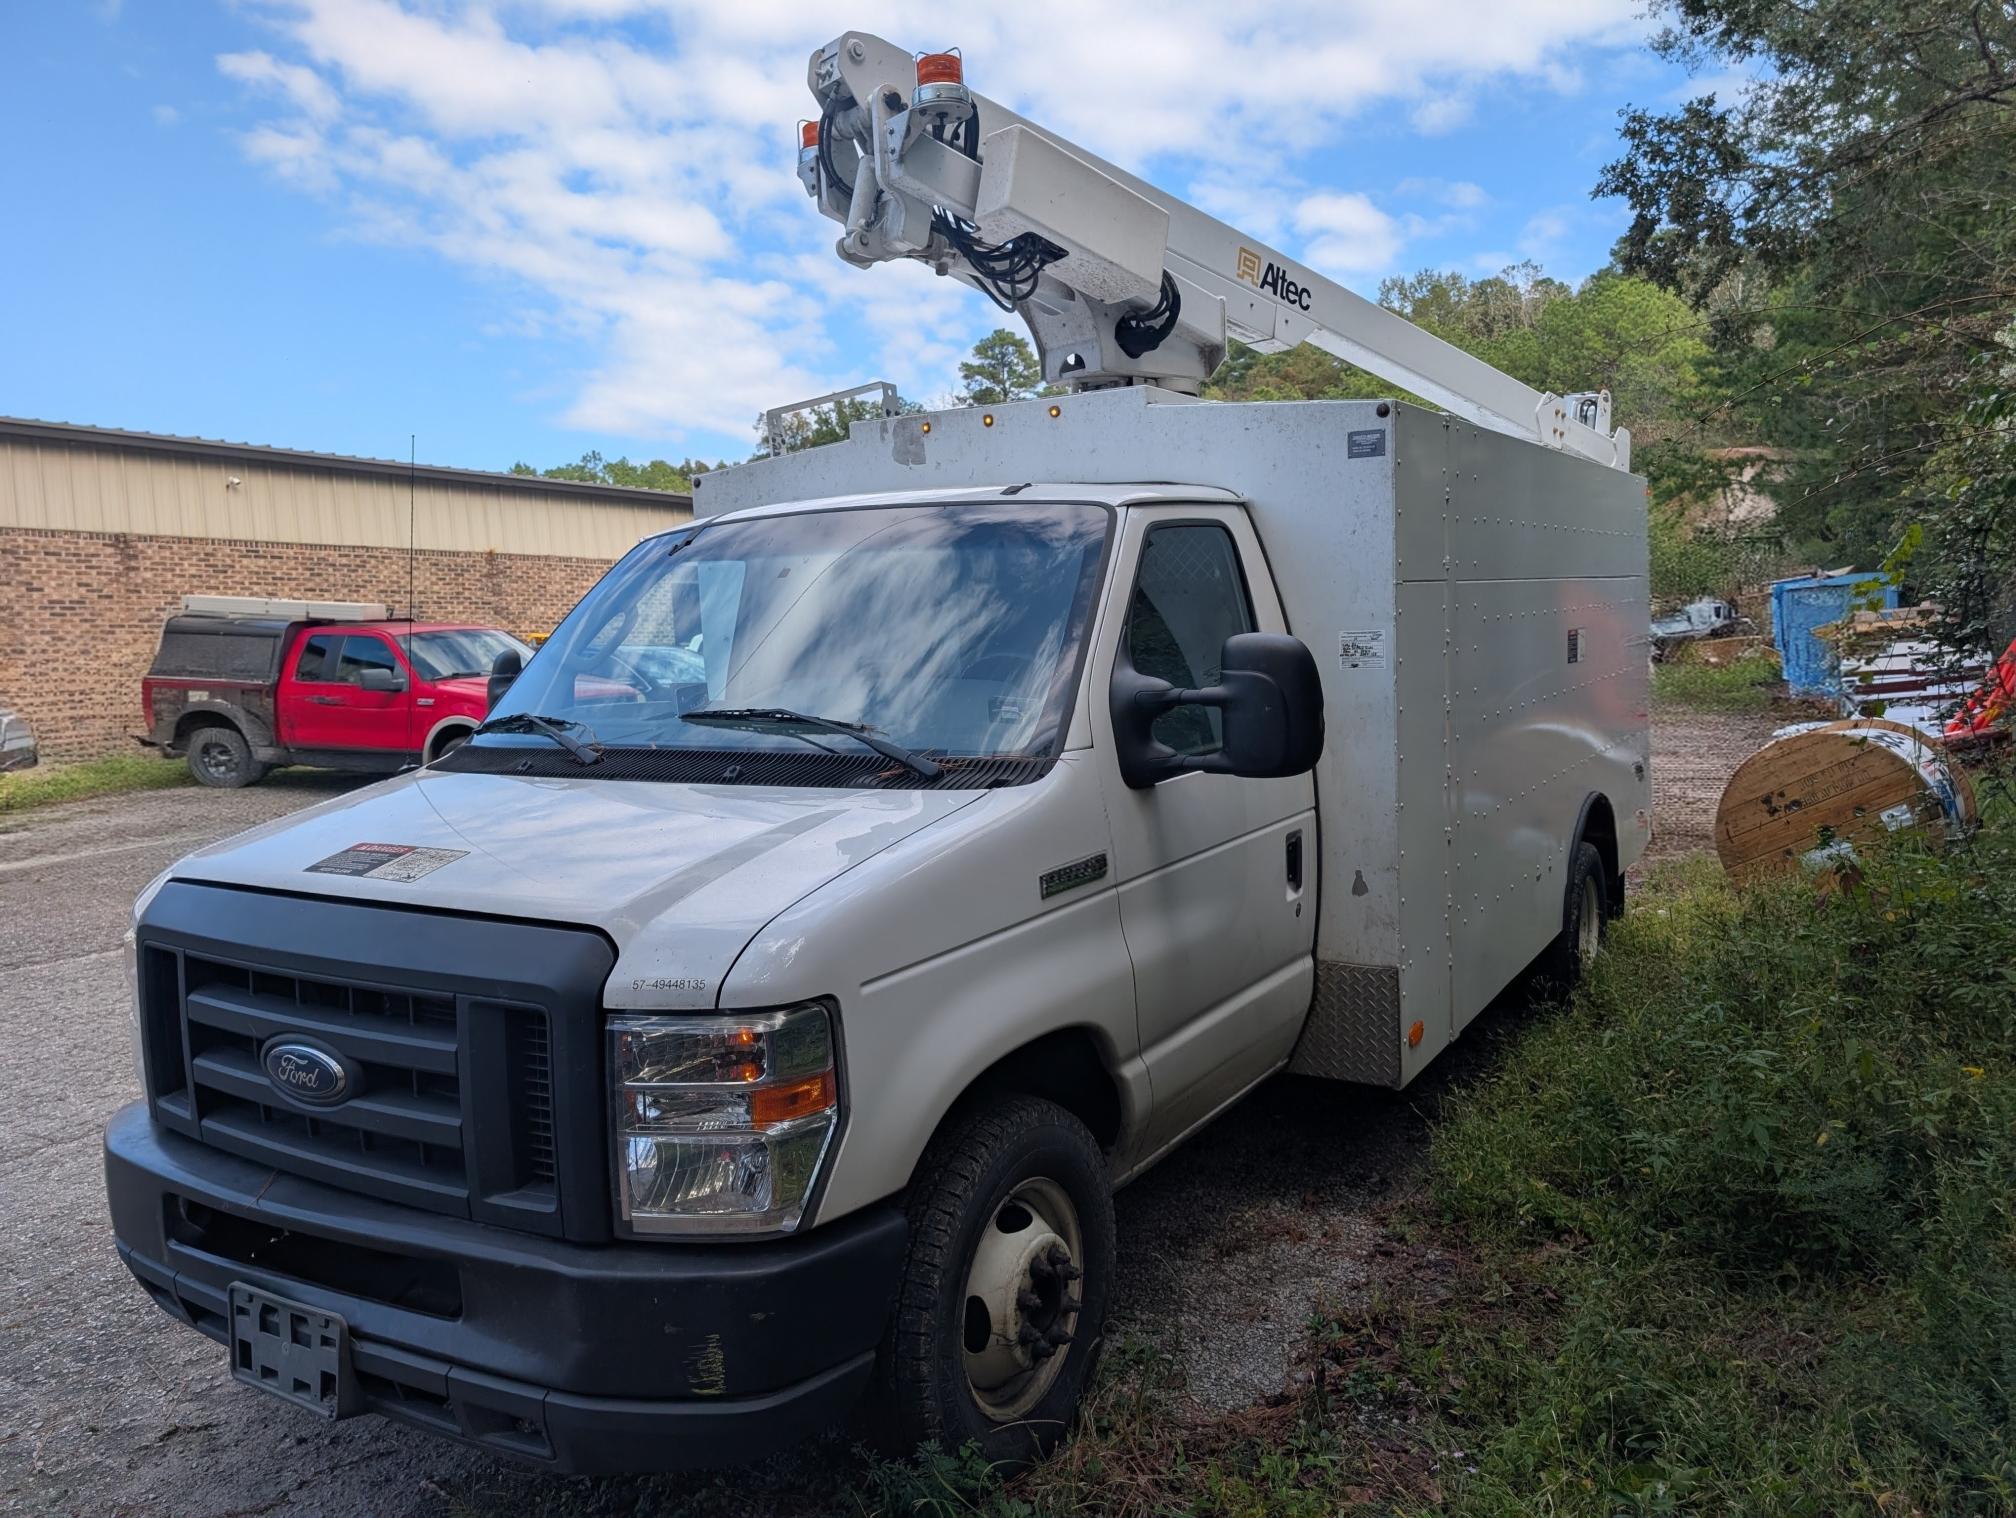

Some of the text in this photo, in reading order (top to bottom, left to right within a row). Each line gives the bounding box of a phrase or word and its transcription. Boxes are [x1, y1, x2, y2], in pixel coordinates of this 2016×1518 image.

[1260, 262, 1311, 311] Altec
[632, 979, 706, 990] 57-49448135
[278, 1054, 320, 1088] Ford
